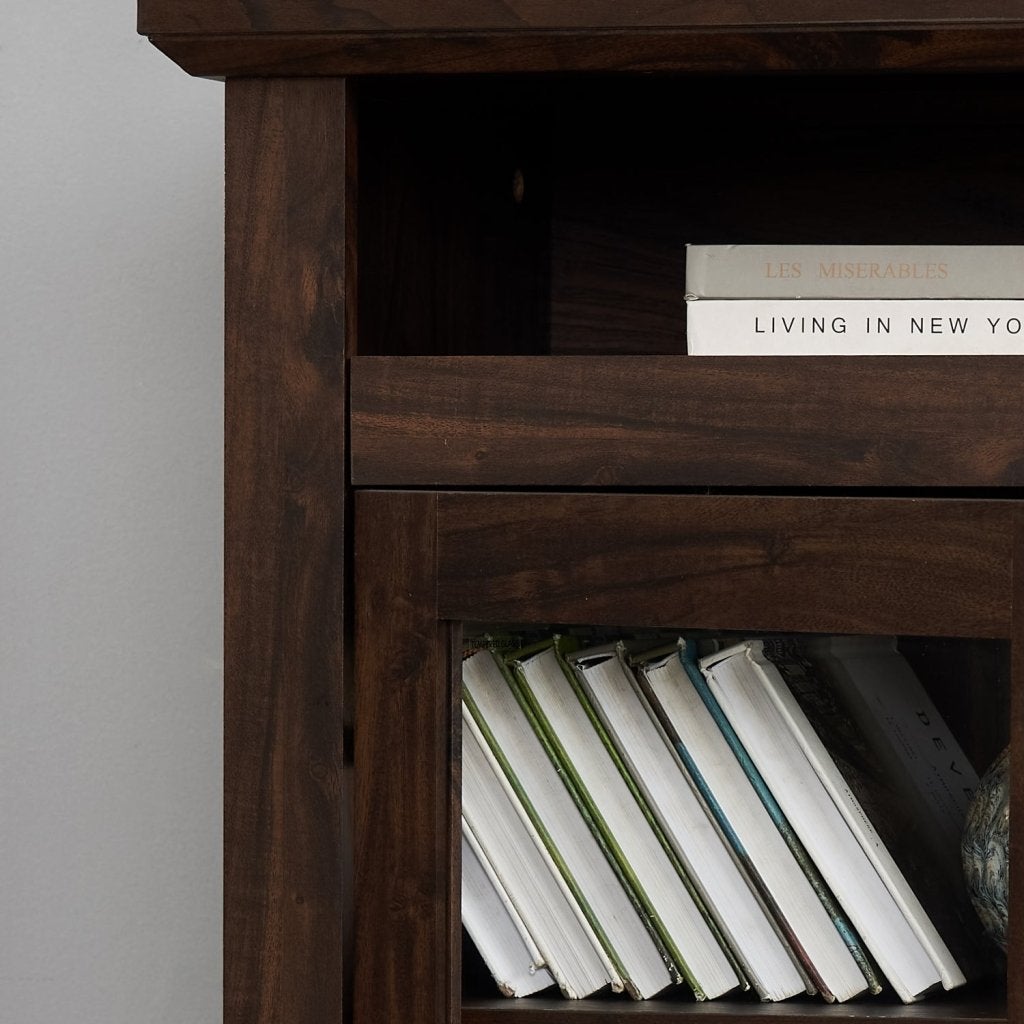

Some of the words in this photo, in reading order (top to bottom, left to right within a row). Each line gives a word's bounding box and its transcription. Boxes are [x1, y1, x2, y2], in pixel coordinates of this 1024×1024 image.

[766, 262, 802, 278] LES
[818, 262, 949, 279] MISERABLES
[754, 316, 848, 334] LIVING
[866, 316, 891, 334] IN
[910, 317, 969, 334] NEW
